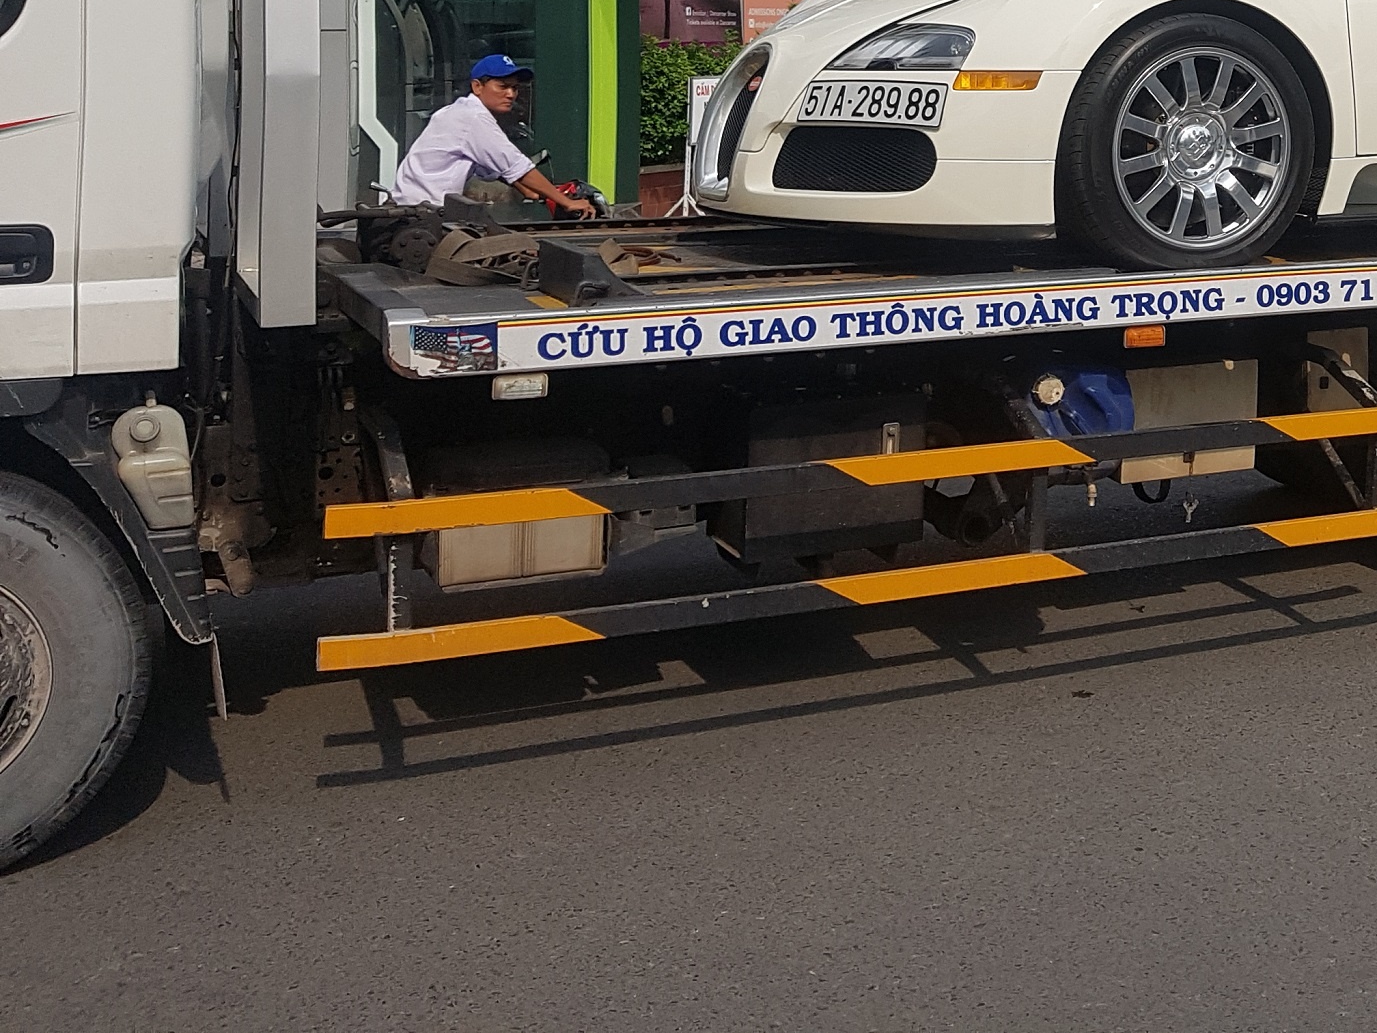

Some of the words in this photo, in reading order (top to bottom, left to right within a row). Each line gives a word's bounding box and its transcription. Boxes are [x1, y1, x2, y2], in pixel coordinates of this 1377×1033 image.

[804, 84, 940, 121] 51A-289.88
[537, 323, 629, 361] CỨU
[642, 316, 703, 357] HỘ
[719, 315, 817, 348] GIAO
[829, 302, 963, 340] THÔNG
[976, 293, 1100, 330] HOÀNG
[1110, 286, 1225, 321] TRỌNG
[1256, 280, 1330, 309] 0903
[1340, 278, 1372, 303] 71
